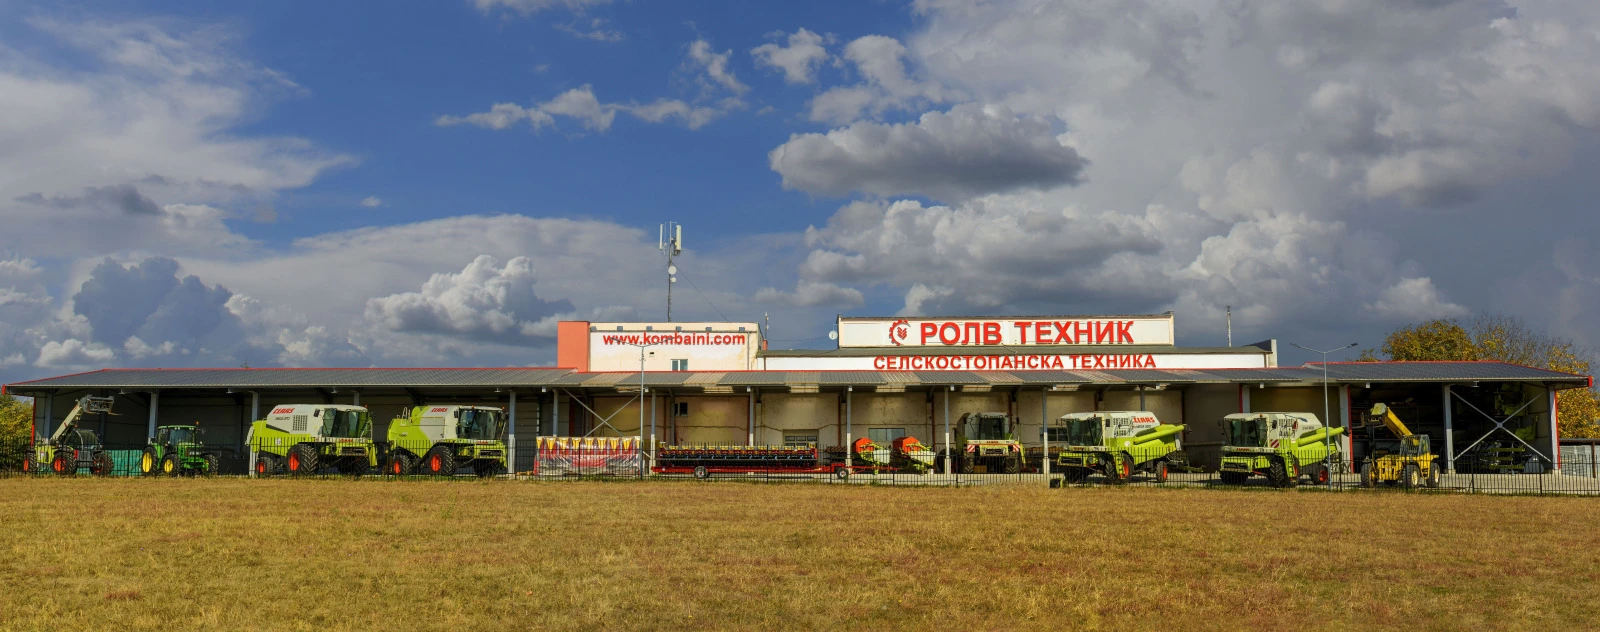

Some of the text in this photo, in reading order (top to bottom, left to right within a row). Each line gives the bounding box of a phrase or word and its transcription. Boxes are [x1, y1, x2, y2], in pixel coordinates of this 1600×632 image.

[602, 332, 746, 345] www.kombaini.com
[921, 320, 1135, 346] РОЛВ ТЕХНИК
[873, 353, 1157, 370] СЕЛСКОСТОПАНСКА ТЕХНИКА
